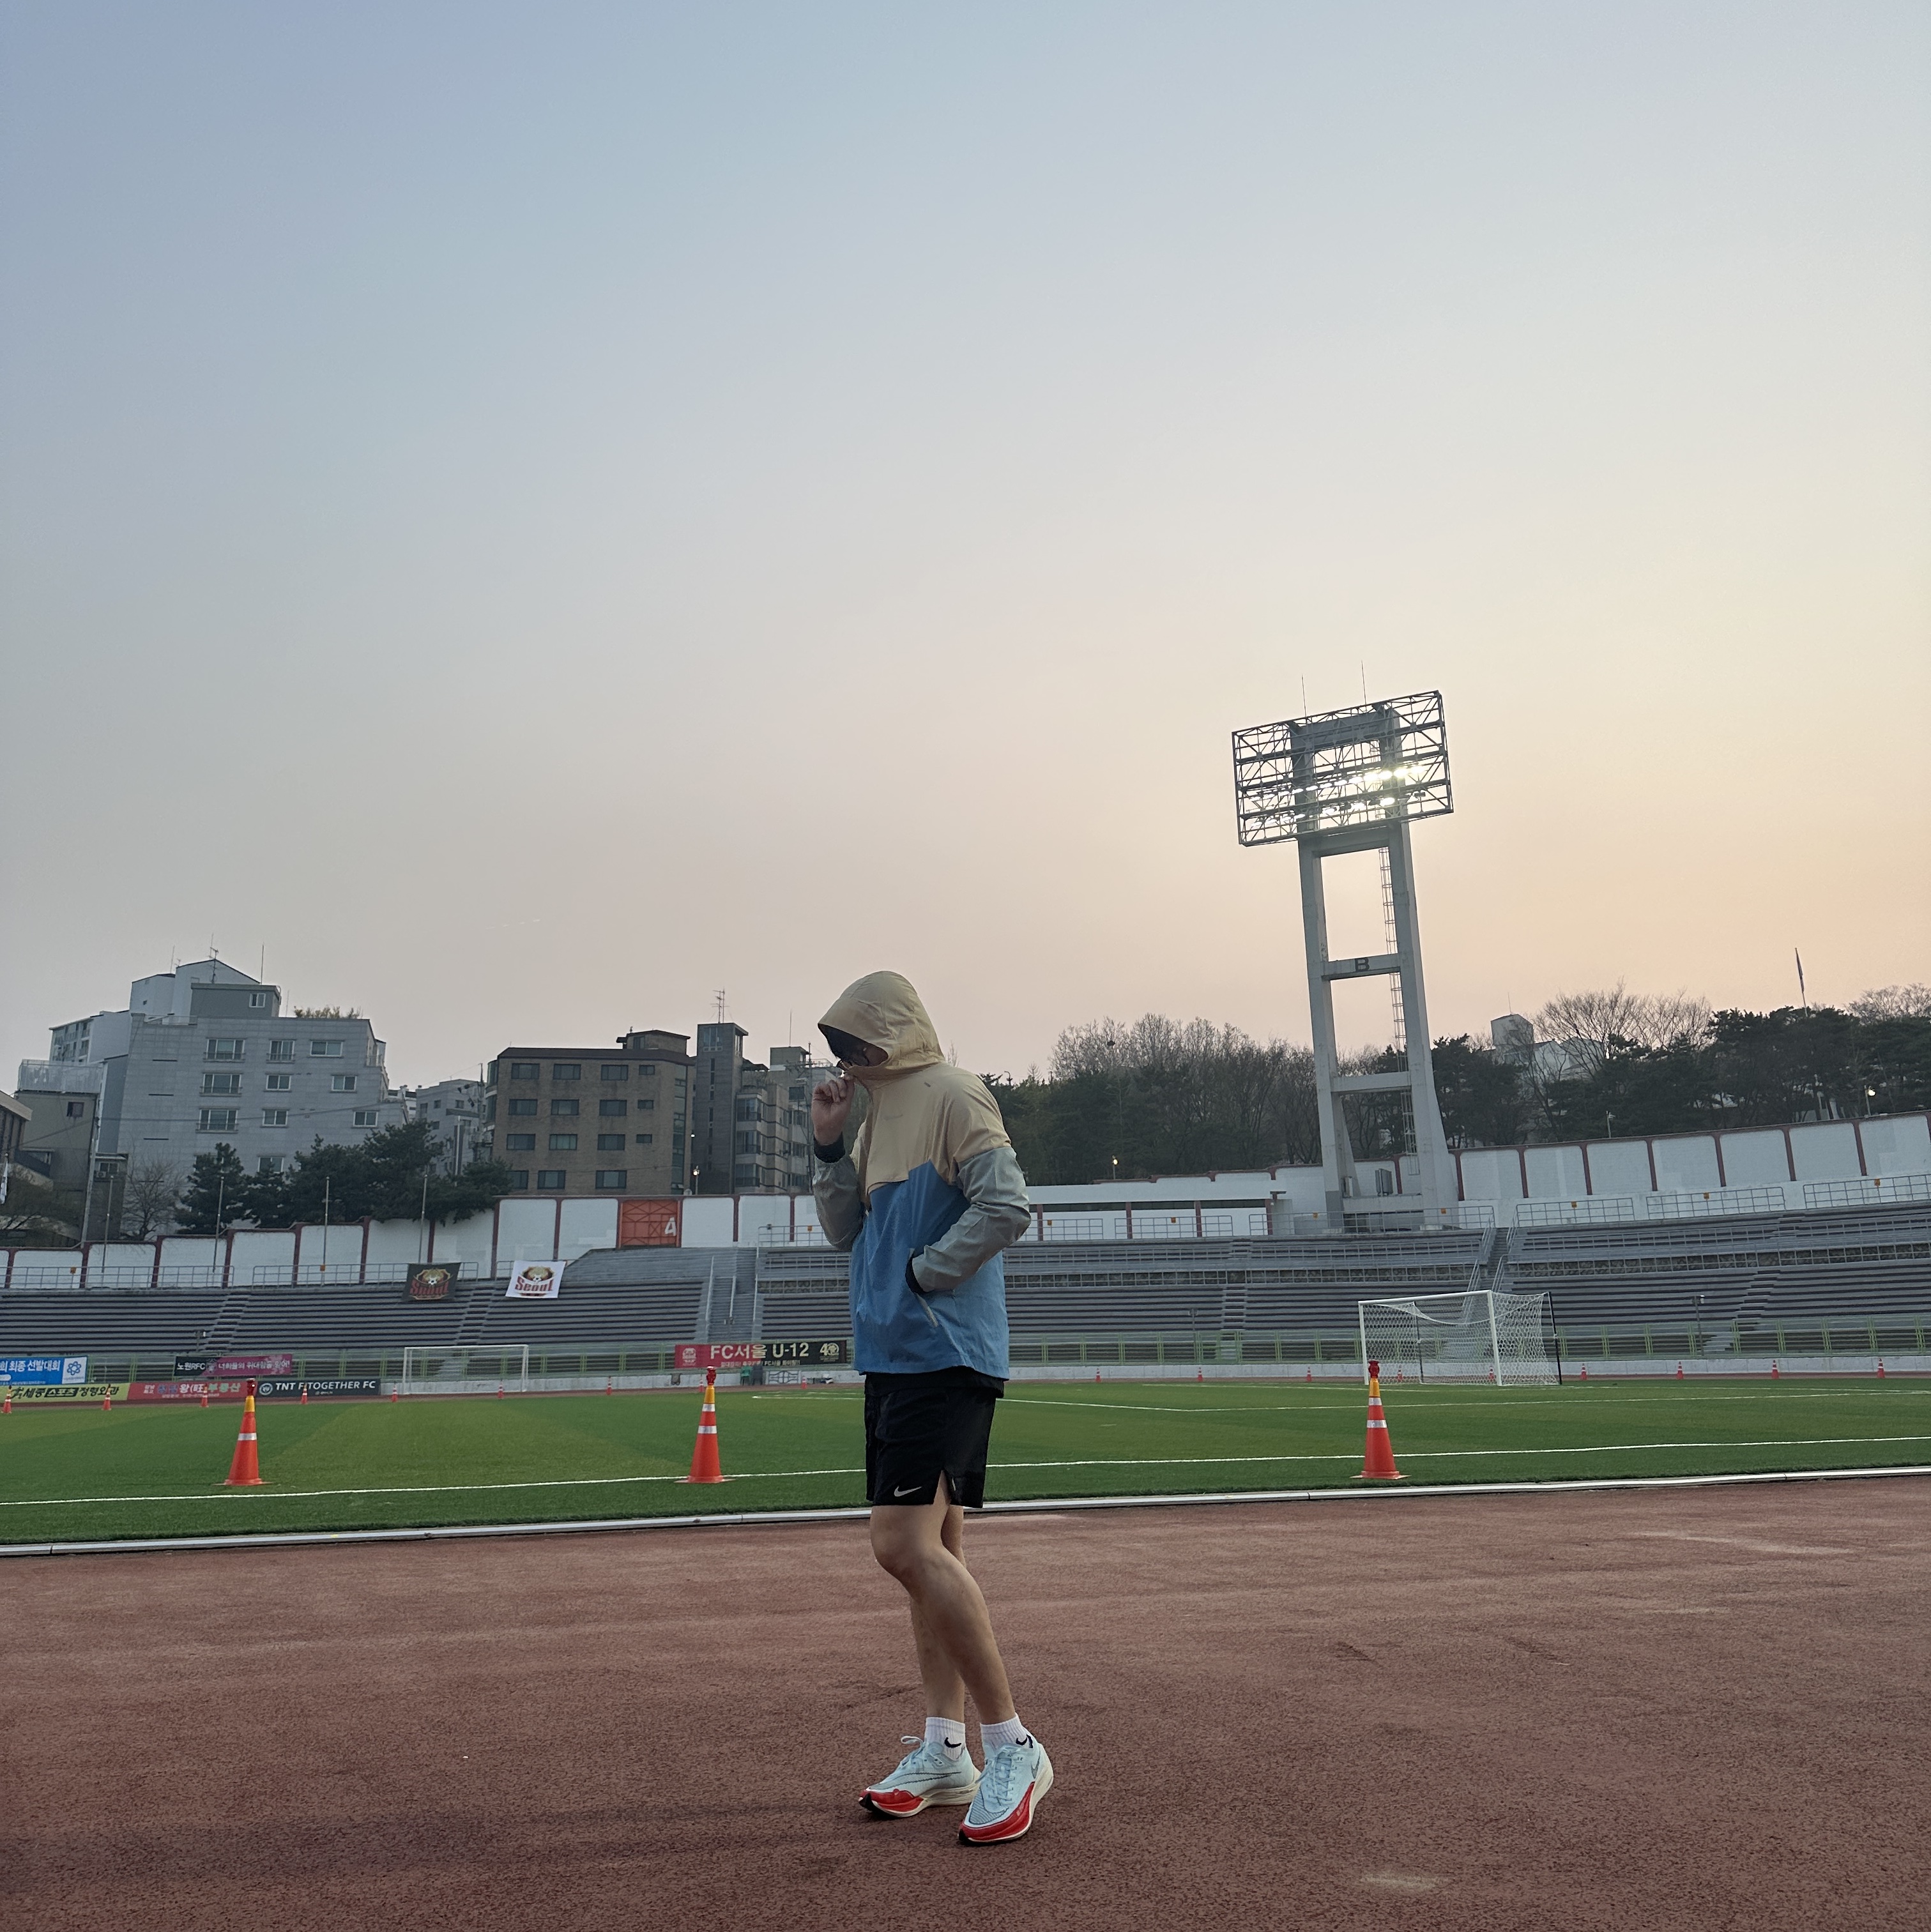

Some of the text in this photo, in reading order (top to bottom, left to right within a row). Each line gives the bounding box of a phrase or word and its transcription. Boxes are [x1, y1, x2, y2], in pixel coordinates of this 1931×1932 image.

[1355, 957, 1370, 972] B
[710, 1343, 809, 1359] FC서울 U-12
[8, 1360, 26, 1373] 최종
[27, 1360, 61, 1372] 선발대회
[275, 1382, 296, 1390] TNT
